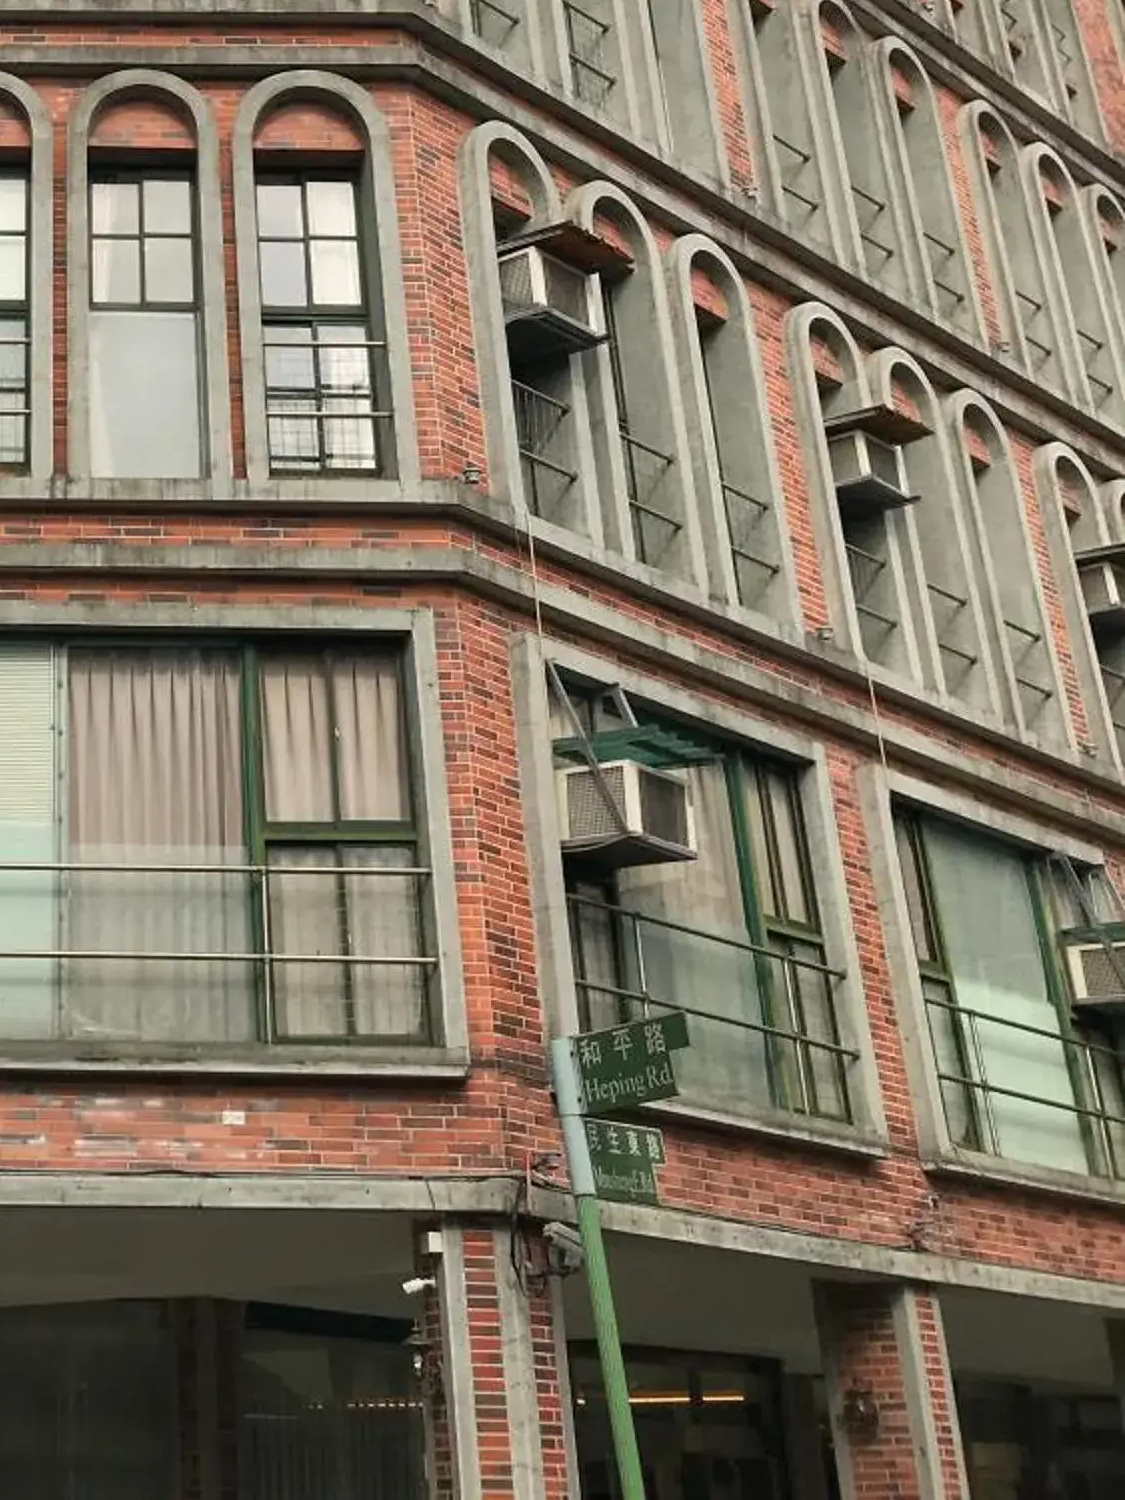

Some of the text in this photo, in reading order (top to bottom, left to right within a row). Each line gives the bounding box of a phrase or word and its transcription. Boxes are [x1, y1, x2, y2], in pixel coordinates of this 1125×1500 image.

[580, 1024, 666, 1069] 和平路
[585, 1073, 645, 1103] Heping
